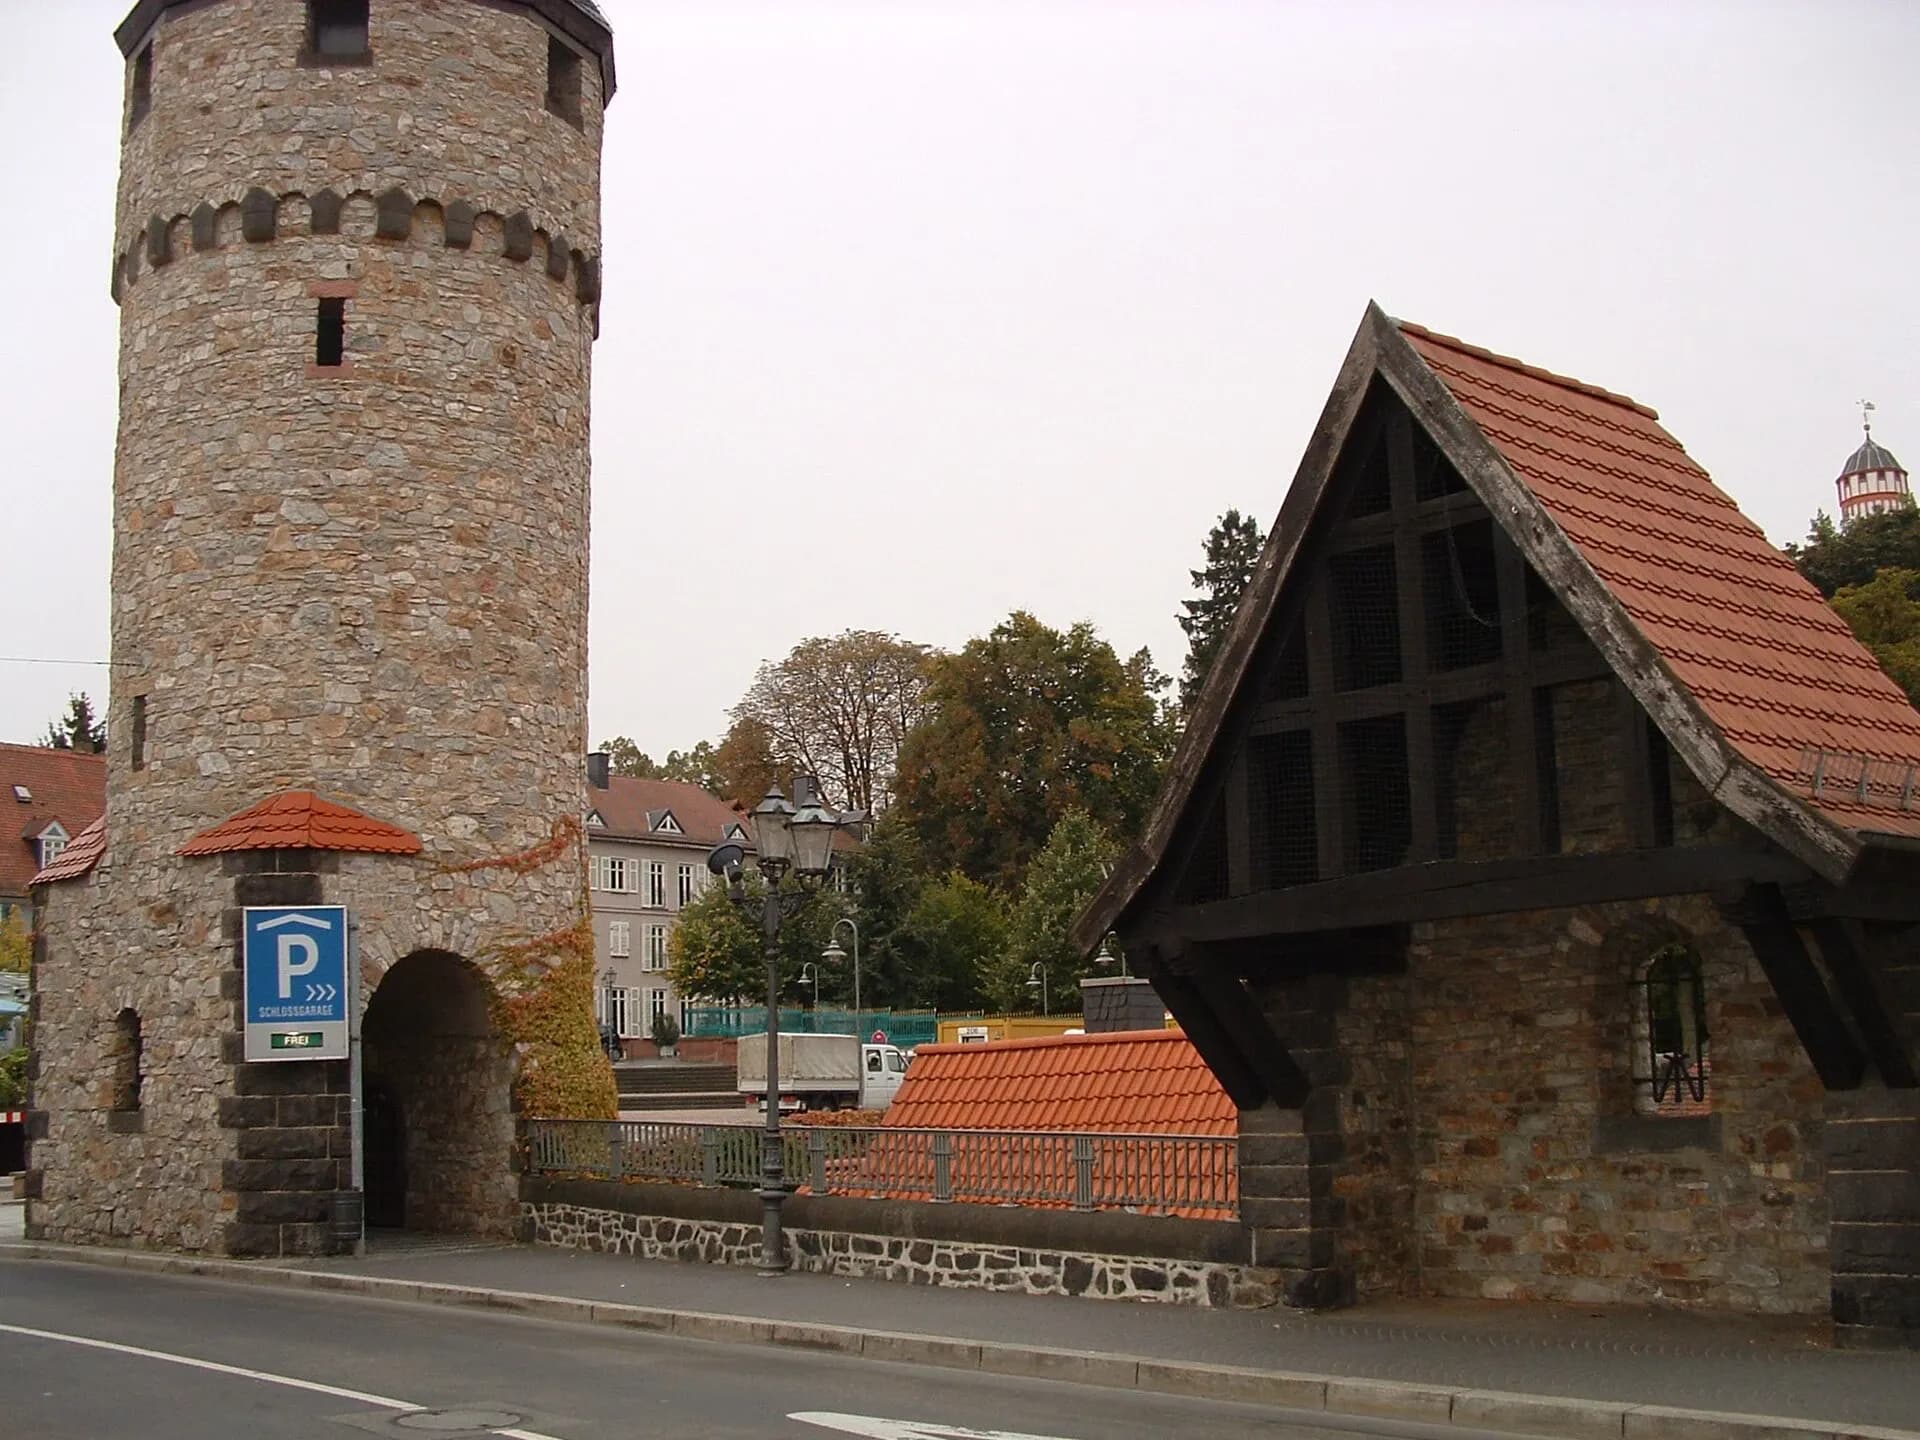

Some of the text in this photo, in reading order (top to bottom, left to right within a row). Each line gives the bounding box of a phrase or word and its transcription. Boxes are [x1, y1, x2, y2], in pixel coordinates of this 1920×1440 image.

[278, 934, 319, 998] P
[258, 1005, 333, 1018] SCHLOSSGARAGE
[284, 1035, 309, 1045] FREI
